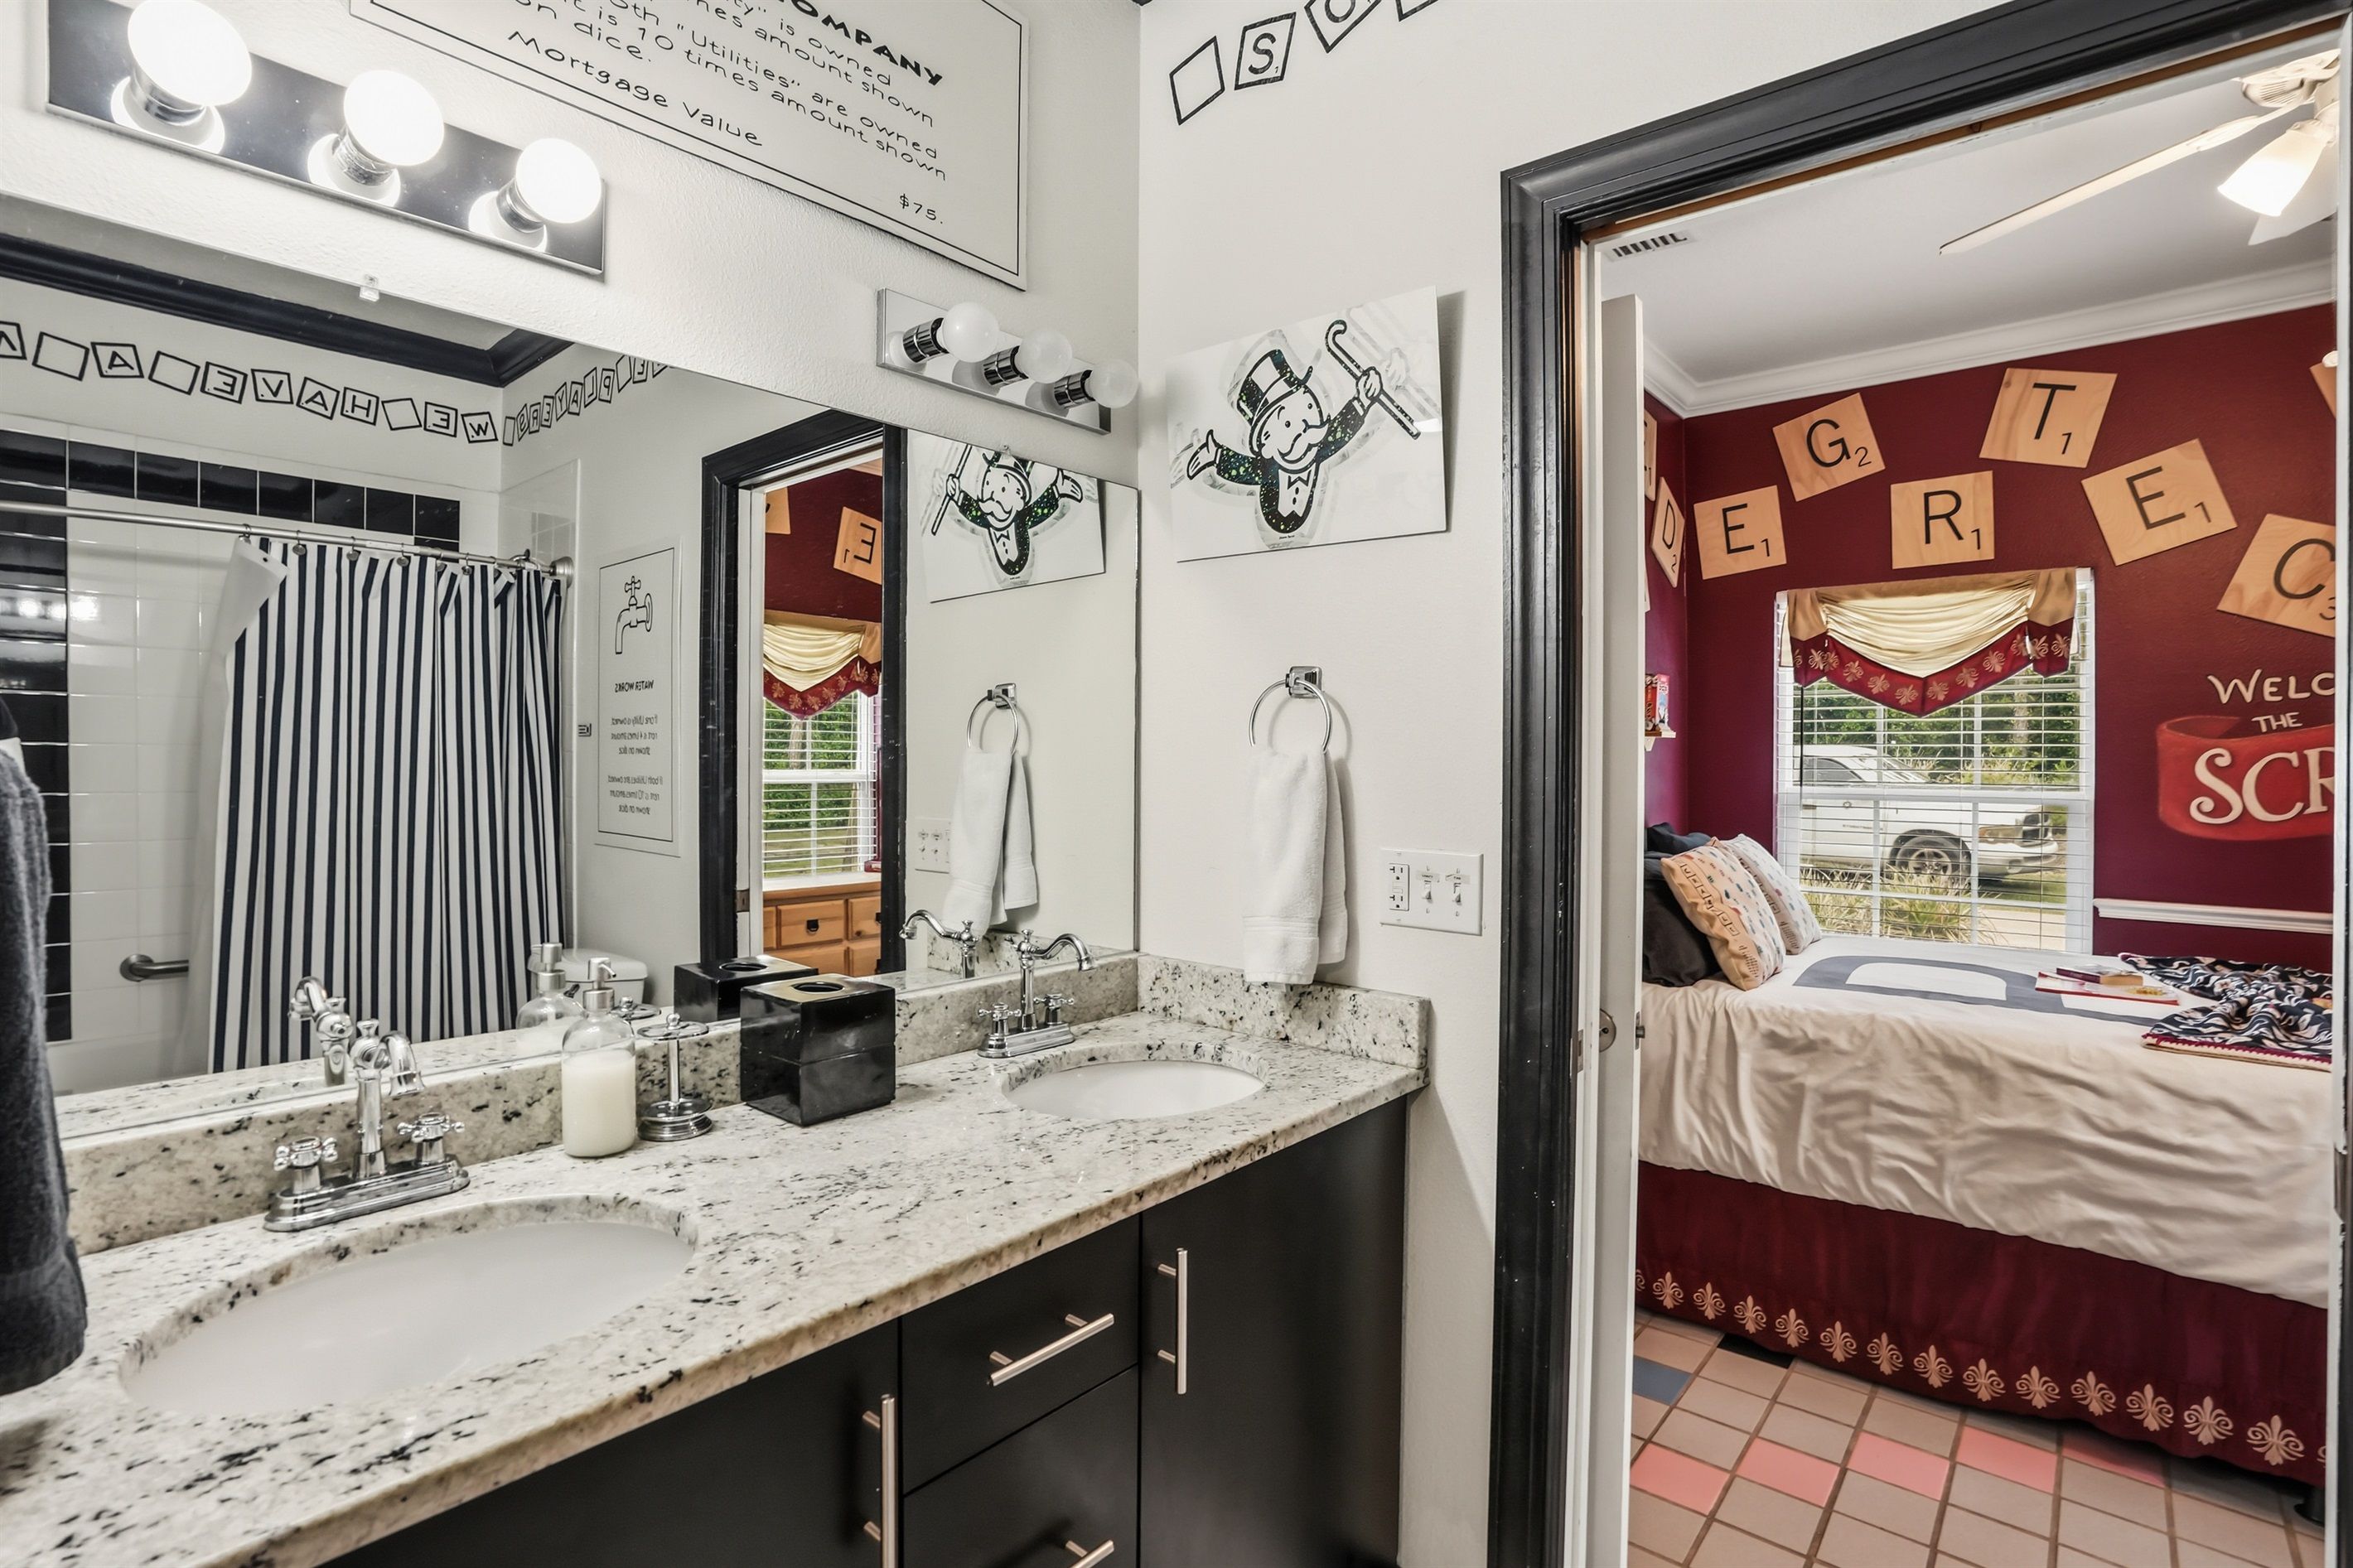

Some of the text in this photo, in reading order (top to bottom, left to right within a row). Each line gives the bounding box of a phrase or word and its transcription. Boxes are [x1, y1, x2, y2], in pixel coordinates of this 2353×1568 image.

[574, 22, 652, 62] dice.
[778, 0, 943, 85] OMPANY
[780, 18, 795, 36] is
[809, 38, 891, 86] owned
[509, 31, 762, 147] Mortgage Value
[599, 7, 945, 181] is 10 times amount shown
[755, 27, 853, 83] amount
[862, 81, 933, 127] shown
[812, 93, 848, 116] are
[860, 117, 937, 158] owned
[900, 194, 944, 224] $75.
[2251, 712, 2303, 732] THE
